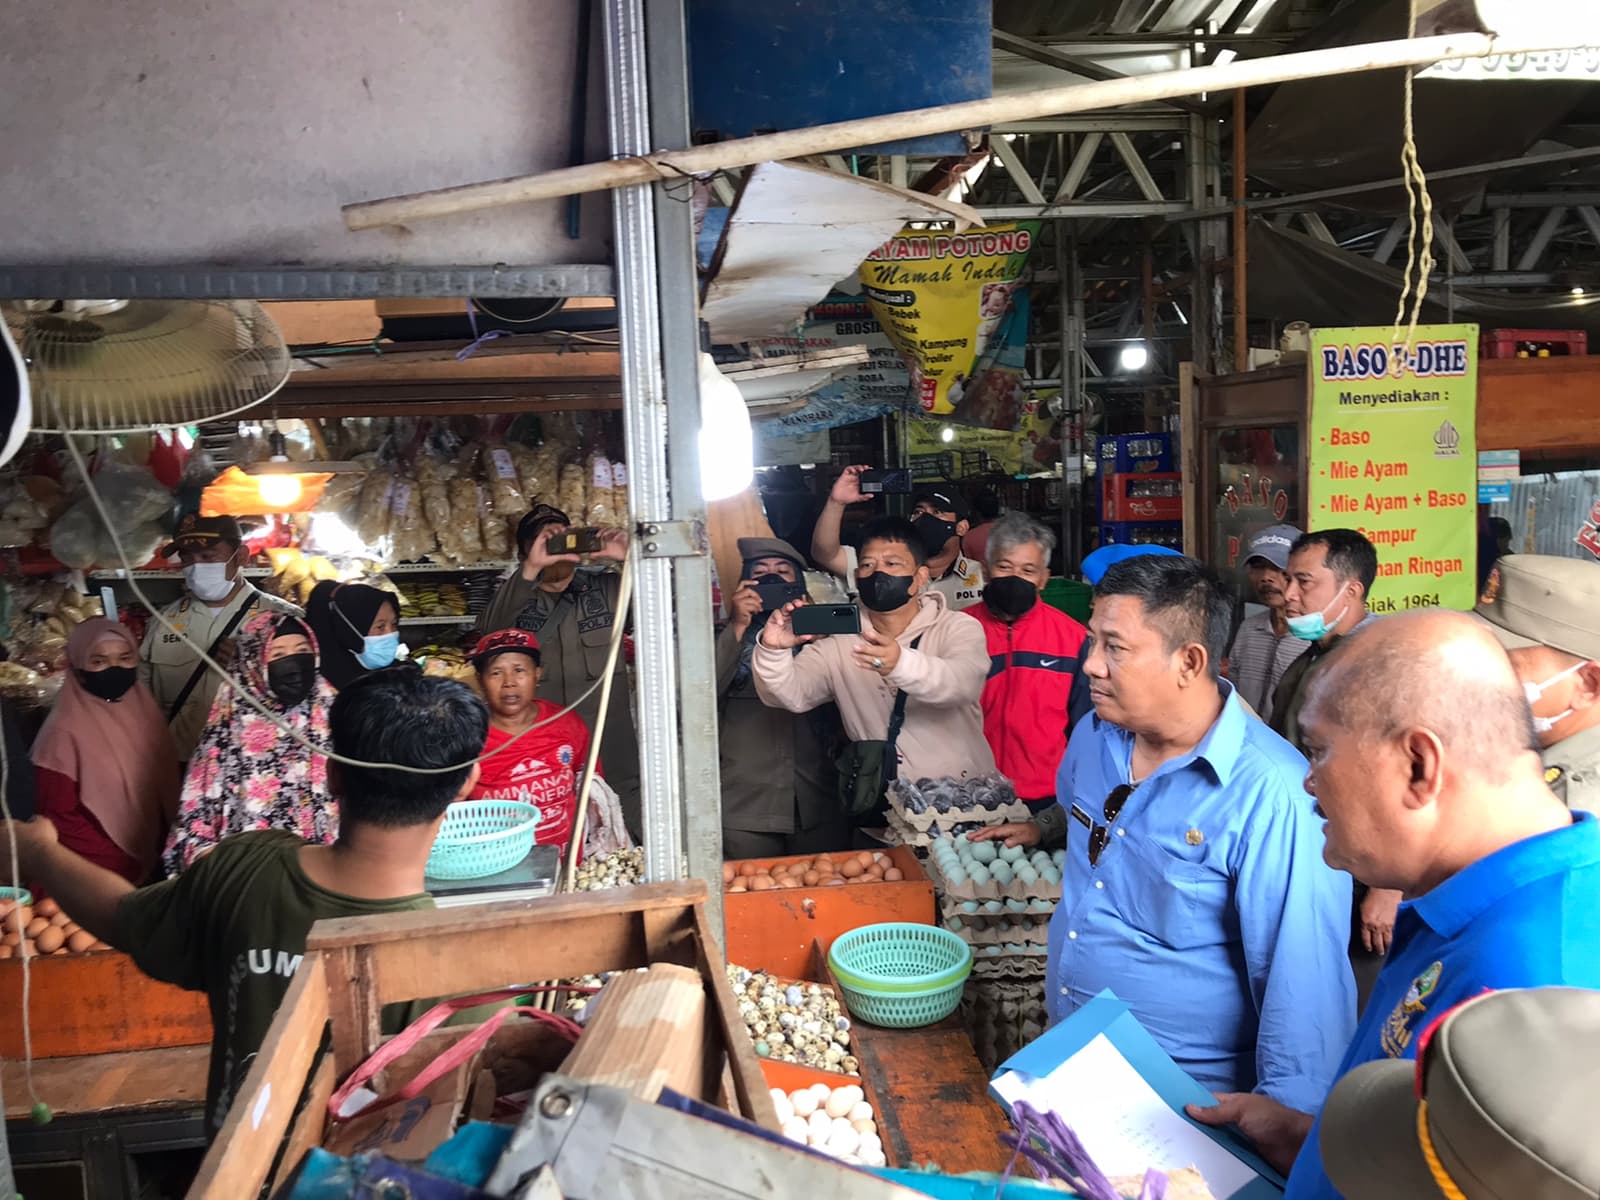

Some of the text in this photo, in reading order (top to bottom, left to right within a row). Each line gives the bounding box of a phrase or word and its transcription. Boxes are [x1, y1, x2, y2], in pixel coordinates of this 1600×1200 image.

[935, 231, 1031, 258] POTONG
[873, 264, 953, 285] Mamah
[920, 338, 968, 350] Kampung
[1322, 345, 1388, 378] BASO
[1339, 390, 1440, 407] Menyediakan
[1330, 427, 1370, 445] Baso
[1330, 461, 1359, 479] Mie
[1364, 460, 1408, 481] Ayam
[1331, 495, 1359, 513] Mie
[1364, 494, 1408, 515] Ayam
[1428, 490, 1467, 507] Baso
[1409, 557, 1462, 577] Ringan
[956, 591, 975, 600] POL
[1363, 593, 1440, 612] ejak 1964
